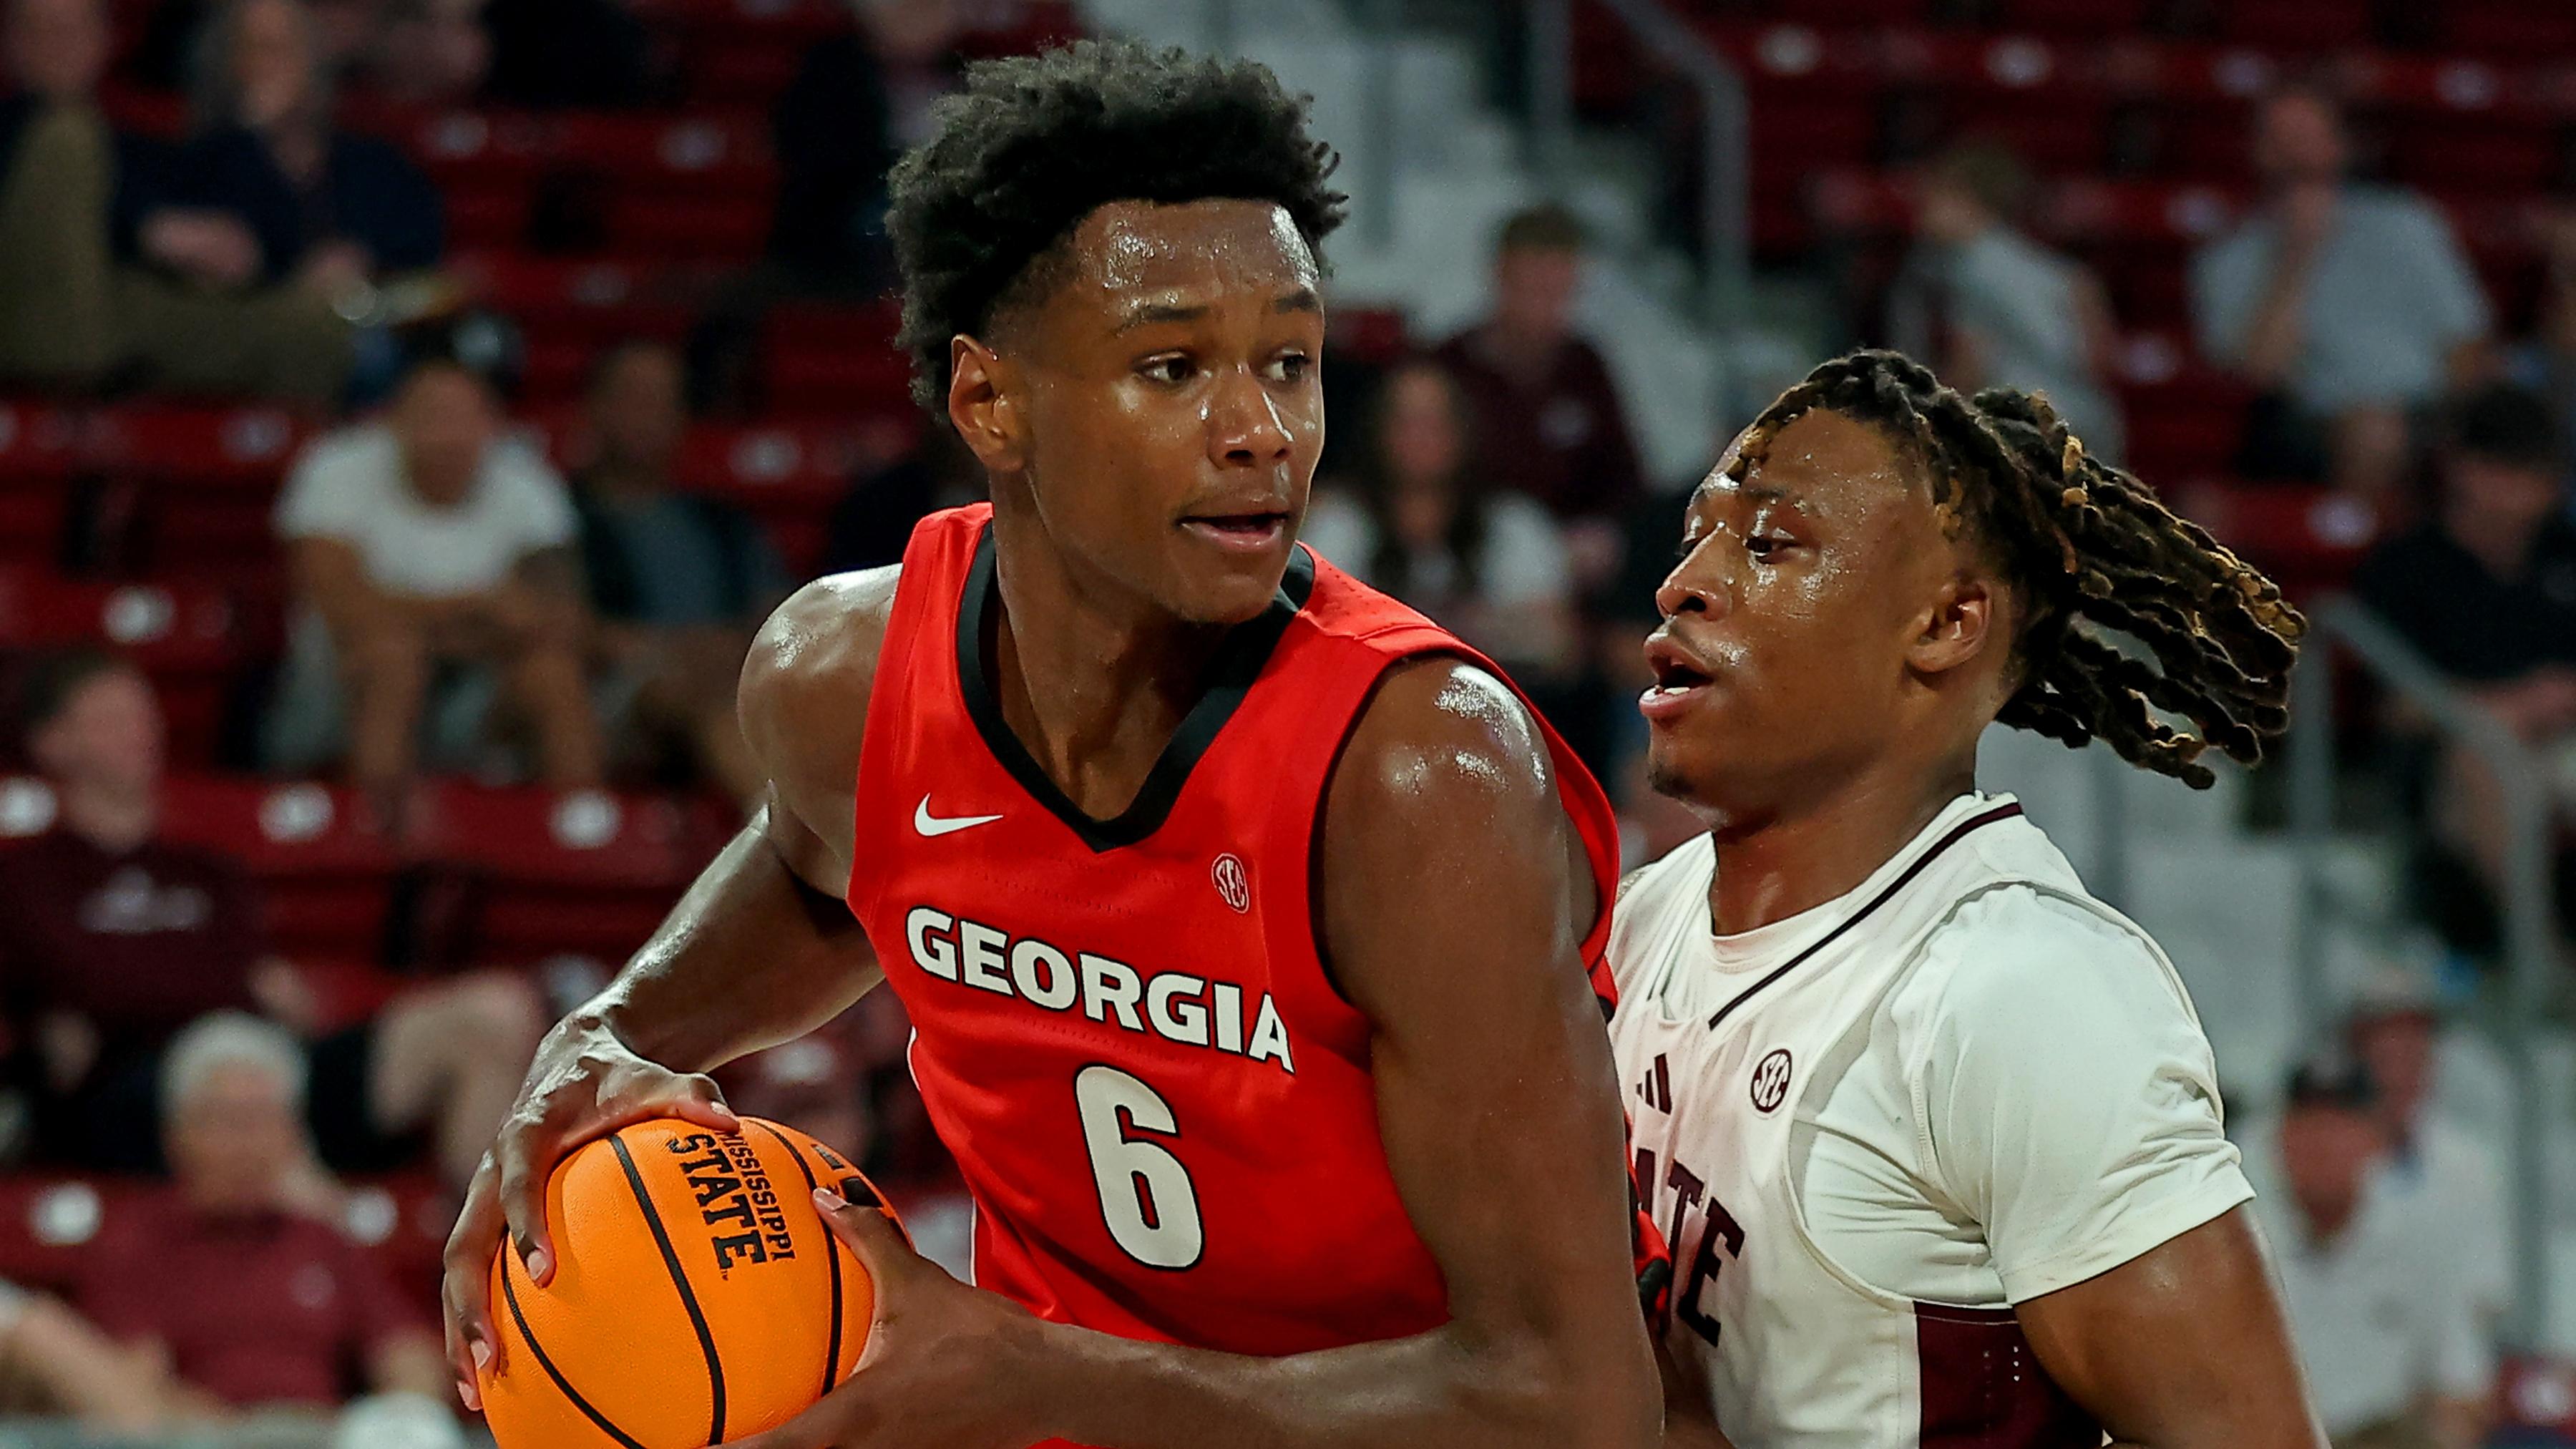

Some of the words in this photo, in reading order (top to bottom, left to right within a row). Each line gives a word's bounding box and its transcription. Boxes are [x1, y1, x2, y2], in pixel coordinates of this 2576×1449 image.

[1215, 858, 1246, 909] SEC
[907, 906, 1296, 1074] GEORGIA
[1752, 1052, 1790, 1108] SEC
[667, 1133, 767, 1270] STATE
[1075, 1065, 1204, 1270] 6
